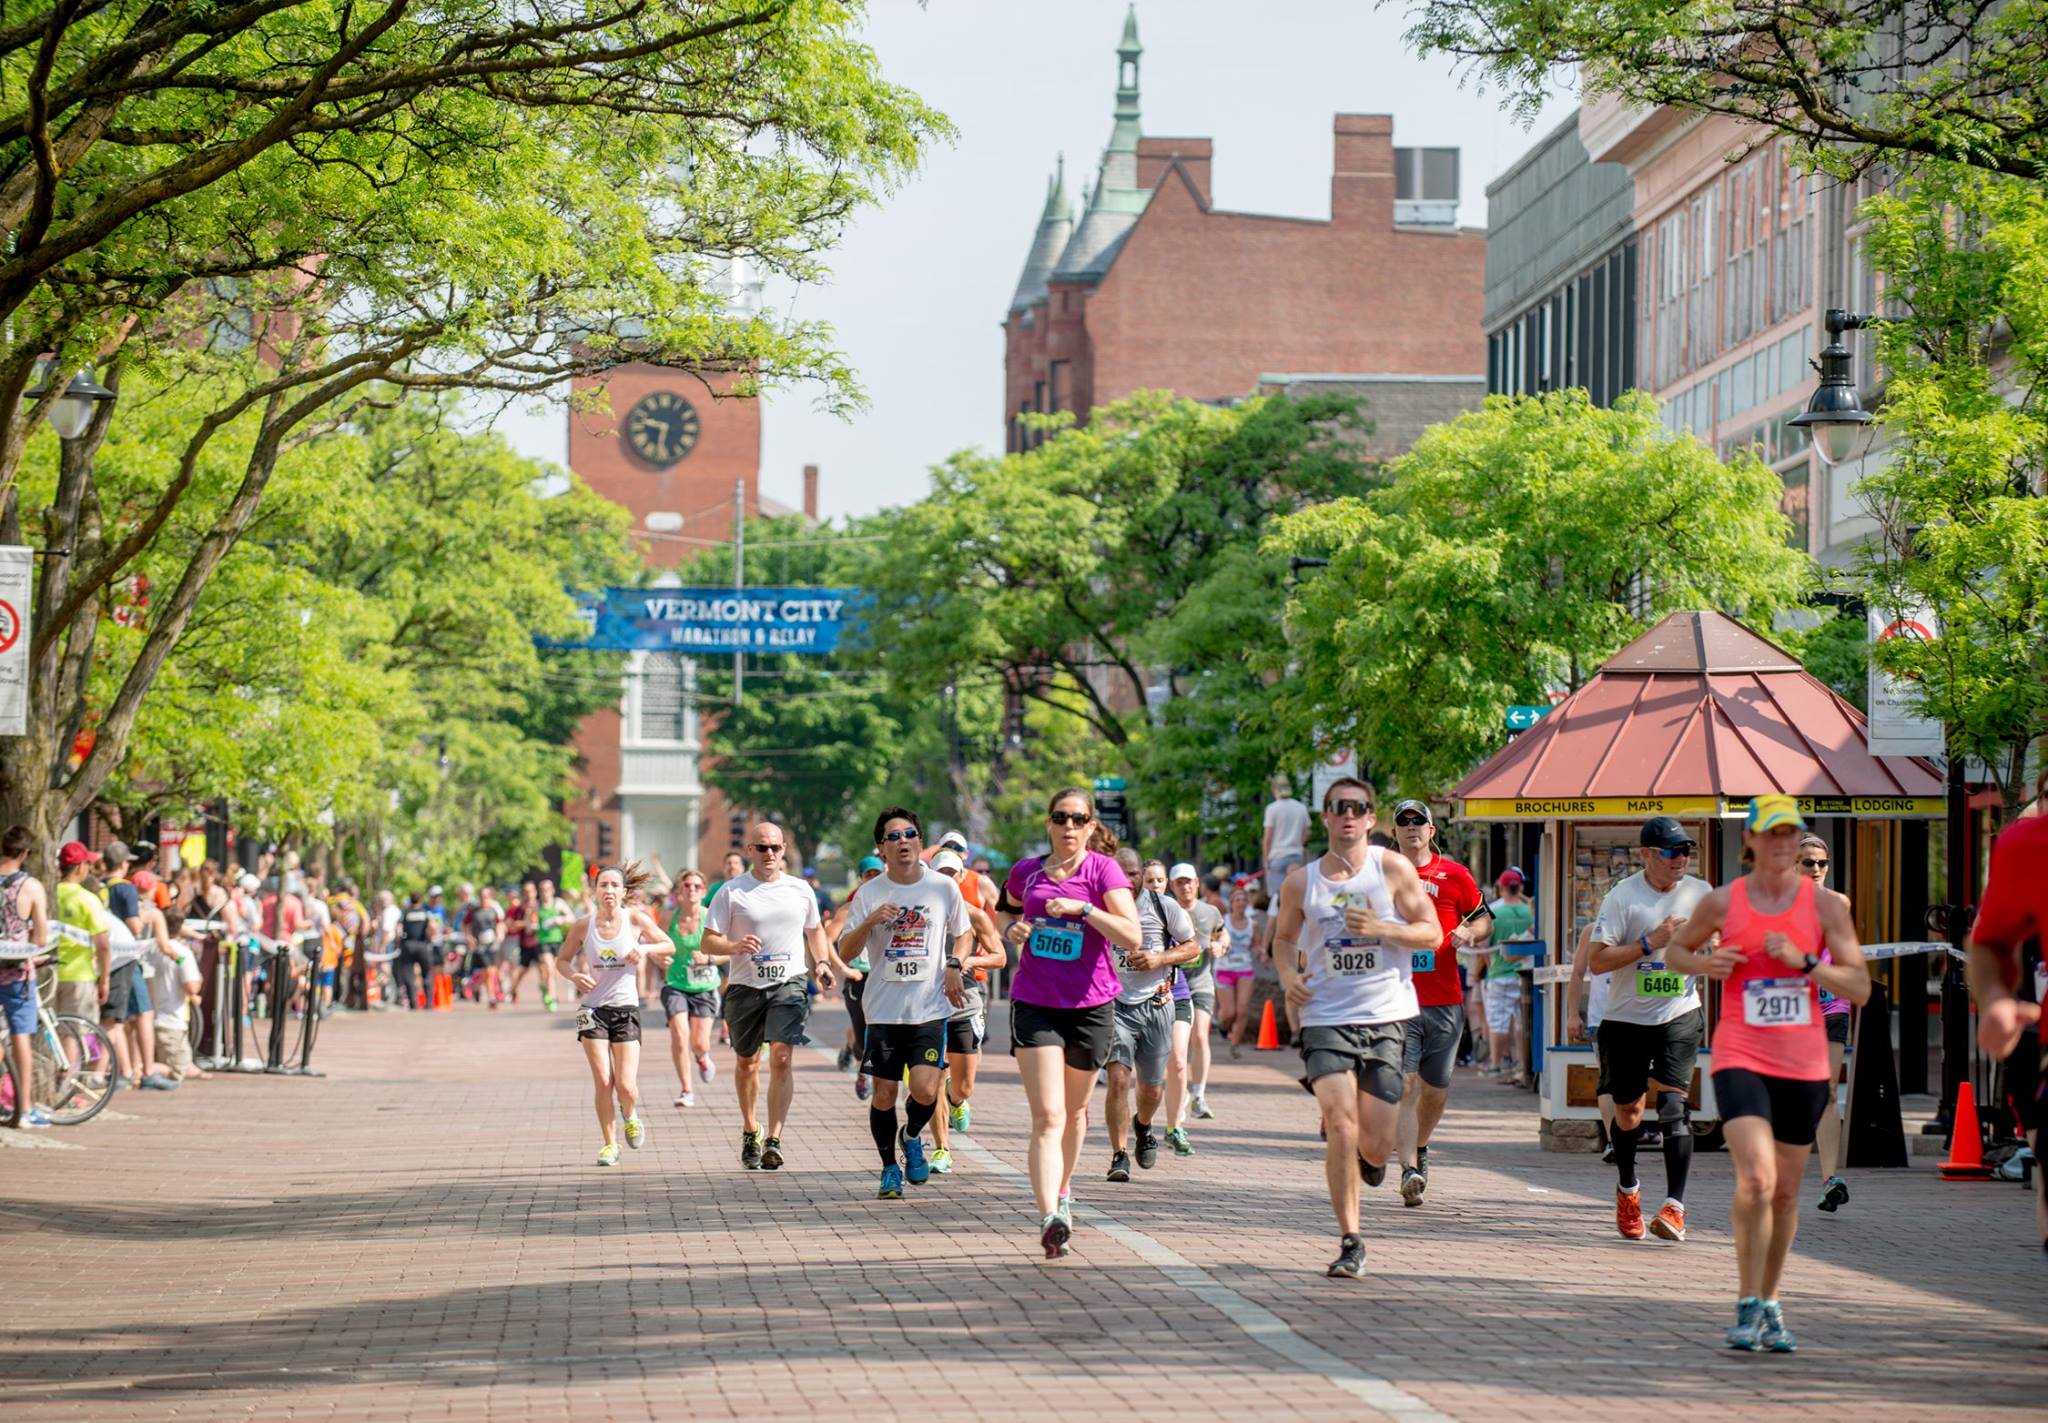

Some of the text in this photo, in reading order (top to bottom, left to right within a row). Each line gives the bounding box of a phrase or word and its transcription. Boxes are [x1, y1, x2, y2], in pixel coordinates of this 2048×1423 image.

[645, 599, 843, 622] VERMONT CITY
[671, 626, 750, 645] MARATHON
[768, 627, 816, 645] RELAY
[1515, 801, 1663, 813] BROCHURES MAPS
[1798, 801, 1812, 811] PS
[1855, 800, 1914, 812] LODGING
[1036, 934, 1073, 956] 5766
[896, 962, 918, 976] 413
[1332, 952, 1375, 971] 3028
[757, 966, 786, 978] 3192
[1643, 977, 1680, 993] 6464
[1756, 996, 1800, 1016] 2971
